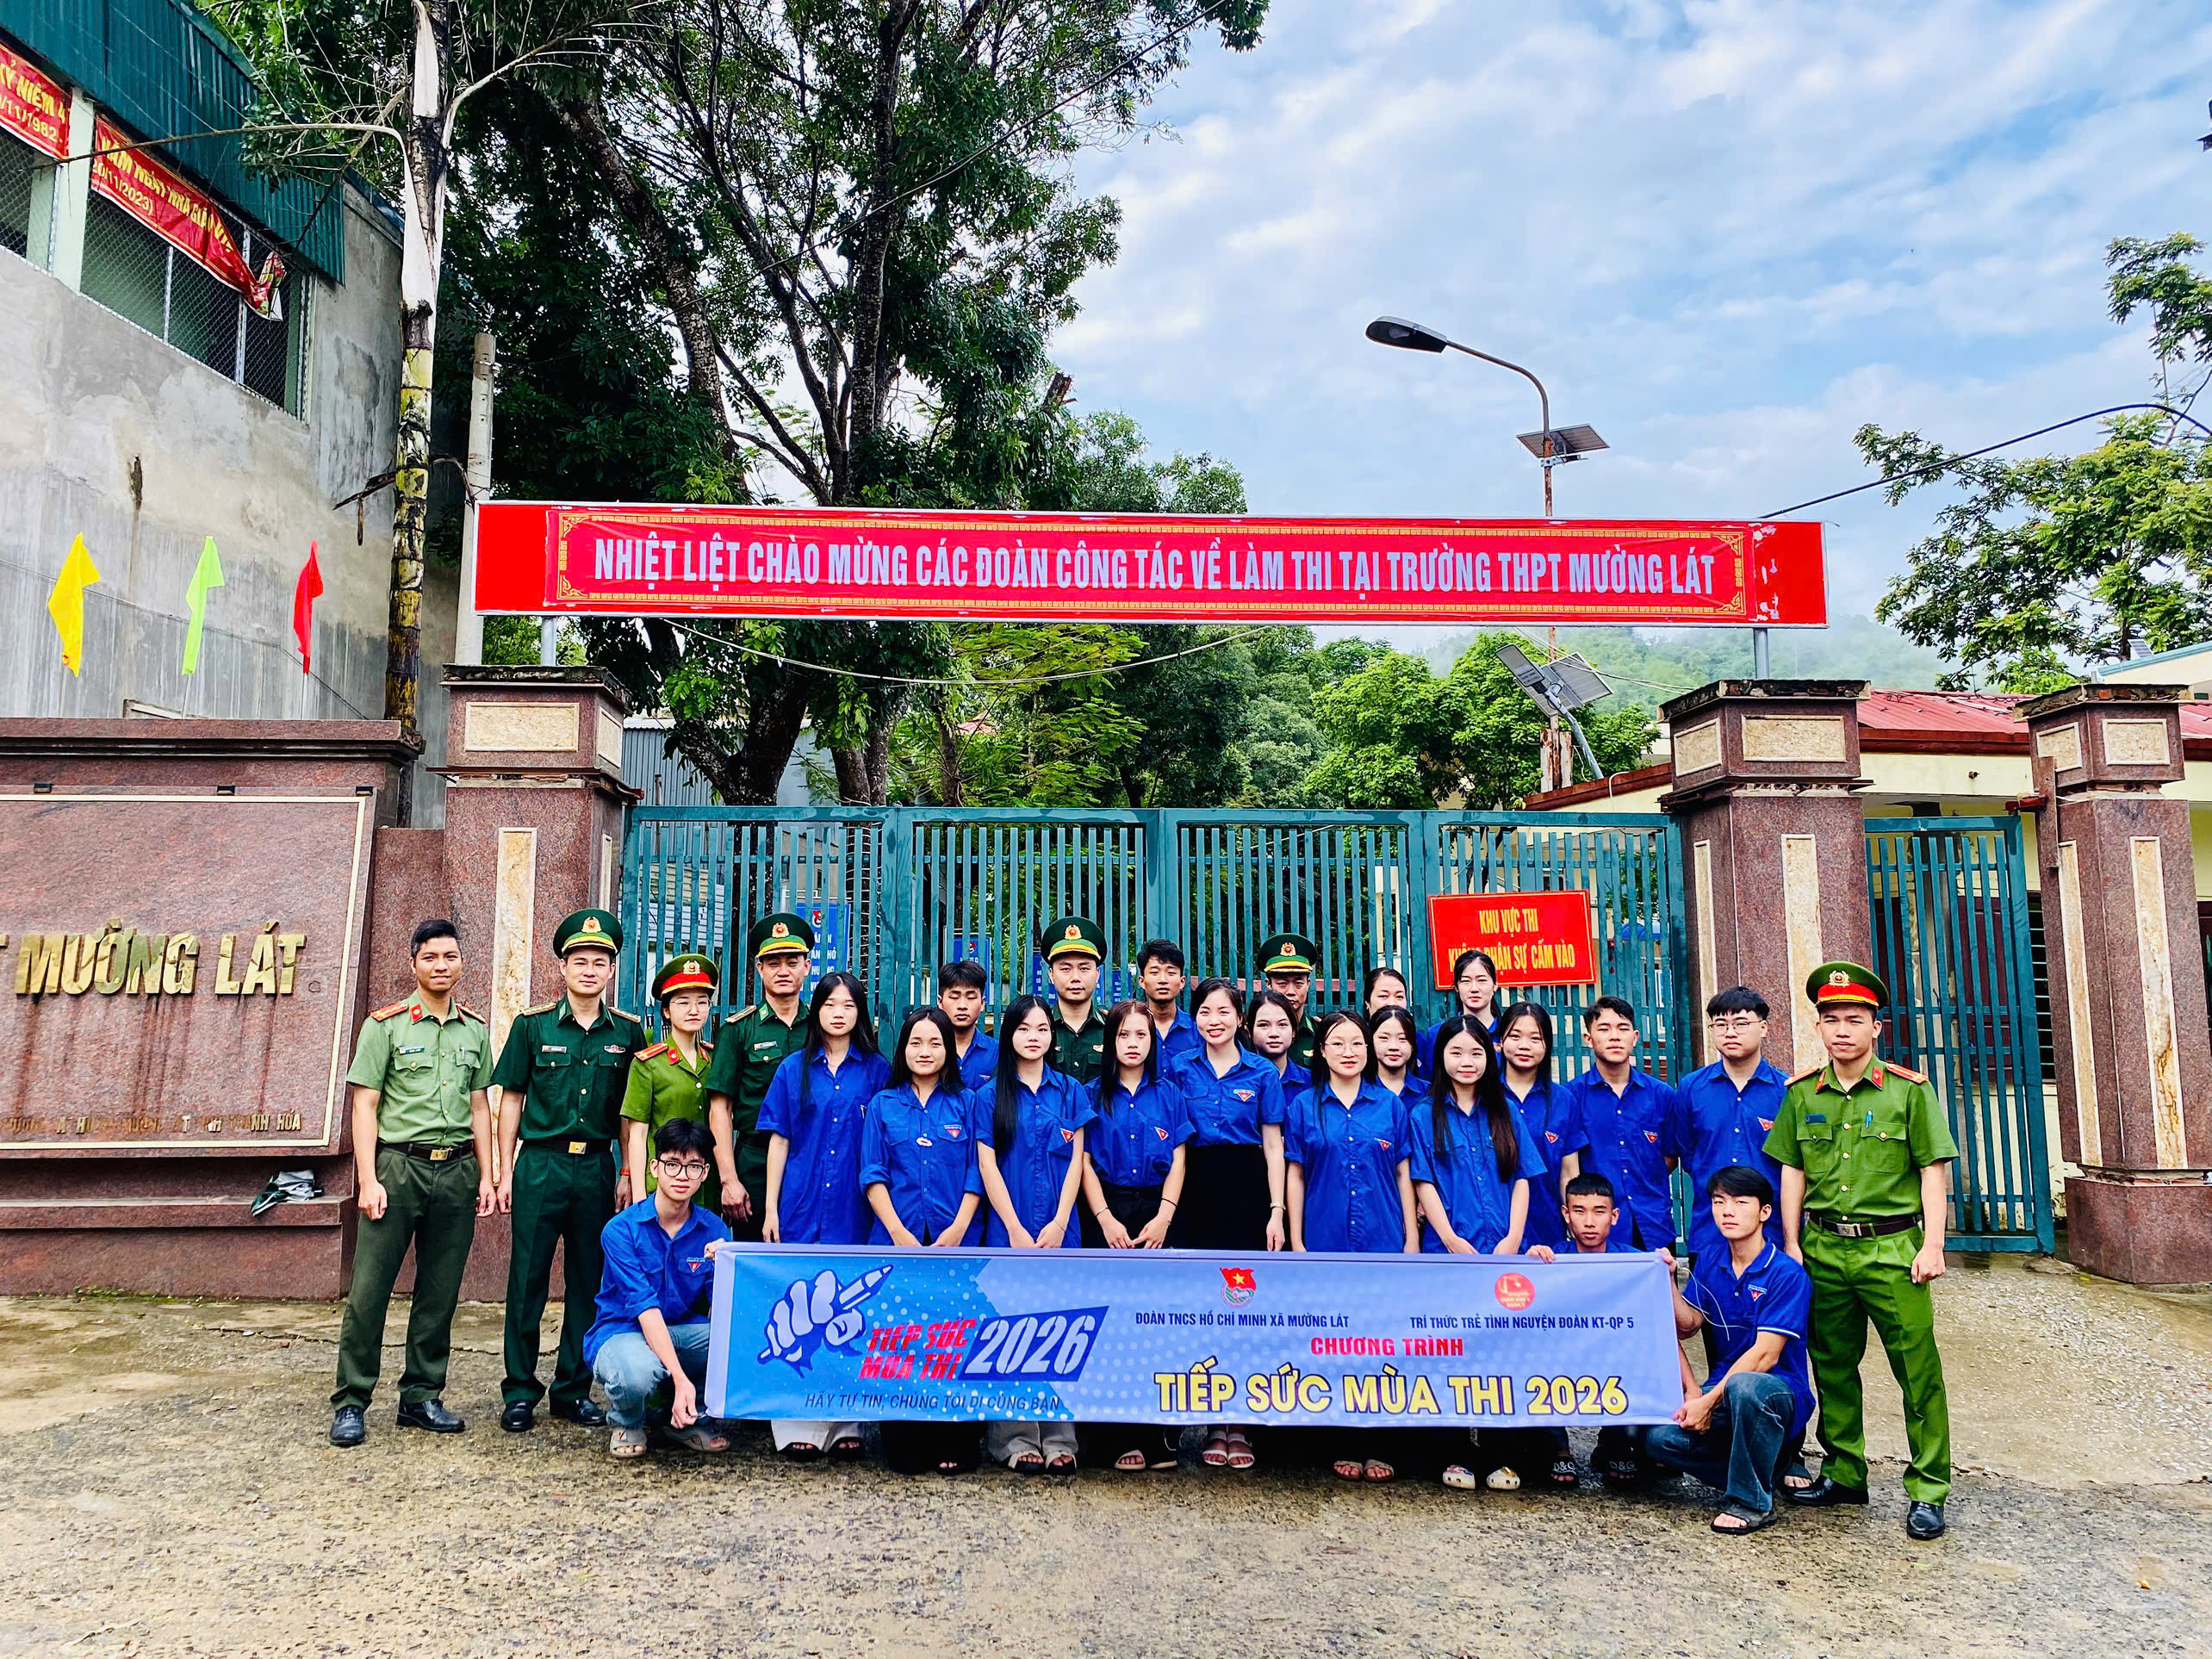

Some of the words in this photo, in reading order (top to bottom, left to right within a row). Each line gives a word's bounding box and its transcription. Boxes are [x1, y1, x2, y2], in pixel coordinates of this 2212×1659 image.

[0, 95, 57, 143] /11/1982
[594, 531, 676, 590] NHIỆT
[684, 532, 741, 592] LIỆT
[748, 535, 819, 585] CHÀO
[828, 536, 908, 587] MỪNG
[916, 537, 968, 587] CÁC
[976, 539, 1048, 588] ĐOÀN
[1057, 540, 1128, 589] CÔNG
[1134, 541, 1183, 590] TÁC
[1190, 537, 1221, 590] VỀ
[1229, 542, 1284, 591] LÀM
[1292, 550, 1332, 591] THI
[1339, 551, 1379, 600] TẠI
[1387, 542, 1491, 593] TRƯỜNG
[1497, 553, 1561, 593] THPT
[1569, 544, 1663, 593] MƯỜNG
[1671, 547, 1714, 594] LÁT
[1479, 910, 1499, 934] KHU
[1501, 906, 1521, 938] VỰC
[1522, 908, 1539, 933] THI
[15, 917, 201, 995] MƯỜNG
[214, 921, 307, 995] LÁT
[1513, 943, 1527, 974] SỰ
[1531, 938, 1554, 970] CẤM
[1555, 939, 1575, 969] VÀO
[276, 1109, 301, 1132] HÓA
[1135, 1312, 1165, 1325] ĐOÀN
[1168, 1314, 1196, 1325] TNCS
[1217, 1310, 1235, 1326] CHÍ
[1238, 1314, 1267, 1327] MINH
[1271, 1313, 1284, 1327] XÃ
[1288, 1313, 1327, 1327] MƯỜNG
[1331, 1314, 1350, 1327] LÁT
[1410, 1314, 1427, 1328] TRÍ
[1430, 1314, 1457, 1328] THỨC
[1461, 1313, 1481, 1328] TRẺ
[1484, 1314, 1509, 1328] TÌNH
[1513, 1314, 1556, 1331] NGUYỆN
[1559, 1314, 1588, 1328] ĐOÀN
[1592, 1316, 1624, 1329] KT-QP
[1627, 1316, 1634, 1328] 5
[965, 1315, 1097, 1375] 2026
[1311, 1336, 1395, 1356] CHƯƠNG
[1401, 1335, 1463, 1357] TRÌNH
[920, 1352, 963, 1380] THI
[1154, 1355, 1237, 1412] TIẾP
[1246, 1362, 1333, 1413] SỨC
[1343, 1363, 1441, 1414] MÙA
[1447, 1376, 1513, 1414] THI
[1525, 1376, 1629, 1415] 2026
[805, 1392, 835, 1408] HÃY
[839, 1393, 858, 1411] TỰ
[891, 1393, 939, 1409] CHÚNG
[943, 1394, 966, 1409] TÔI
[969, 1395, 984, 1408] ĐI
[984, 1392, 1028, 1409] CÙNG
[1030, 1395, 1060, 1411] BẠN
